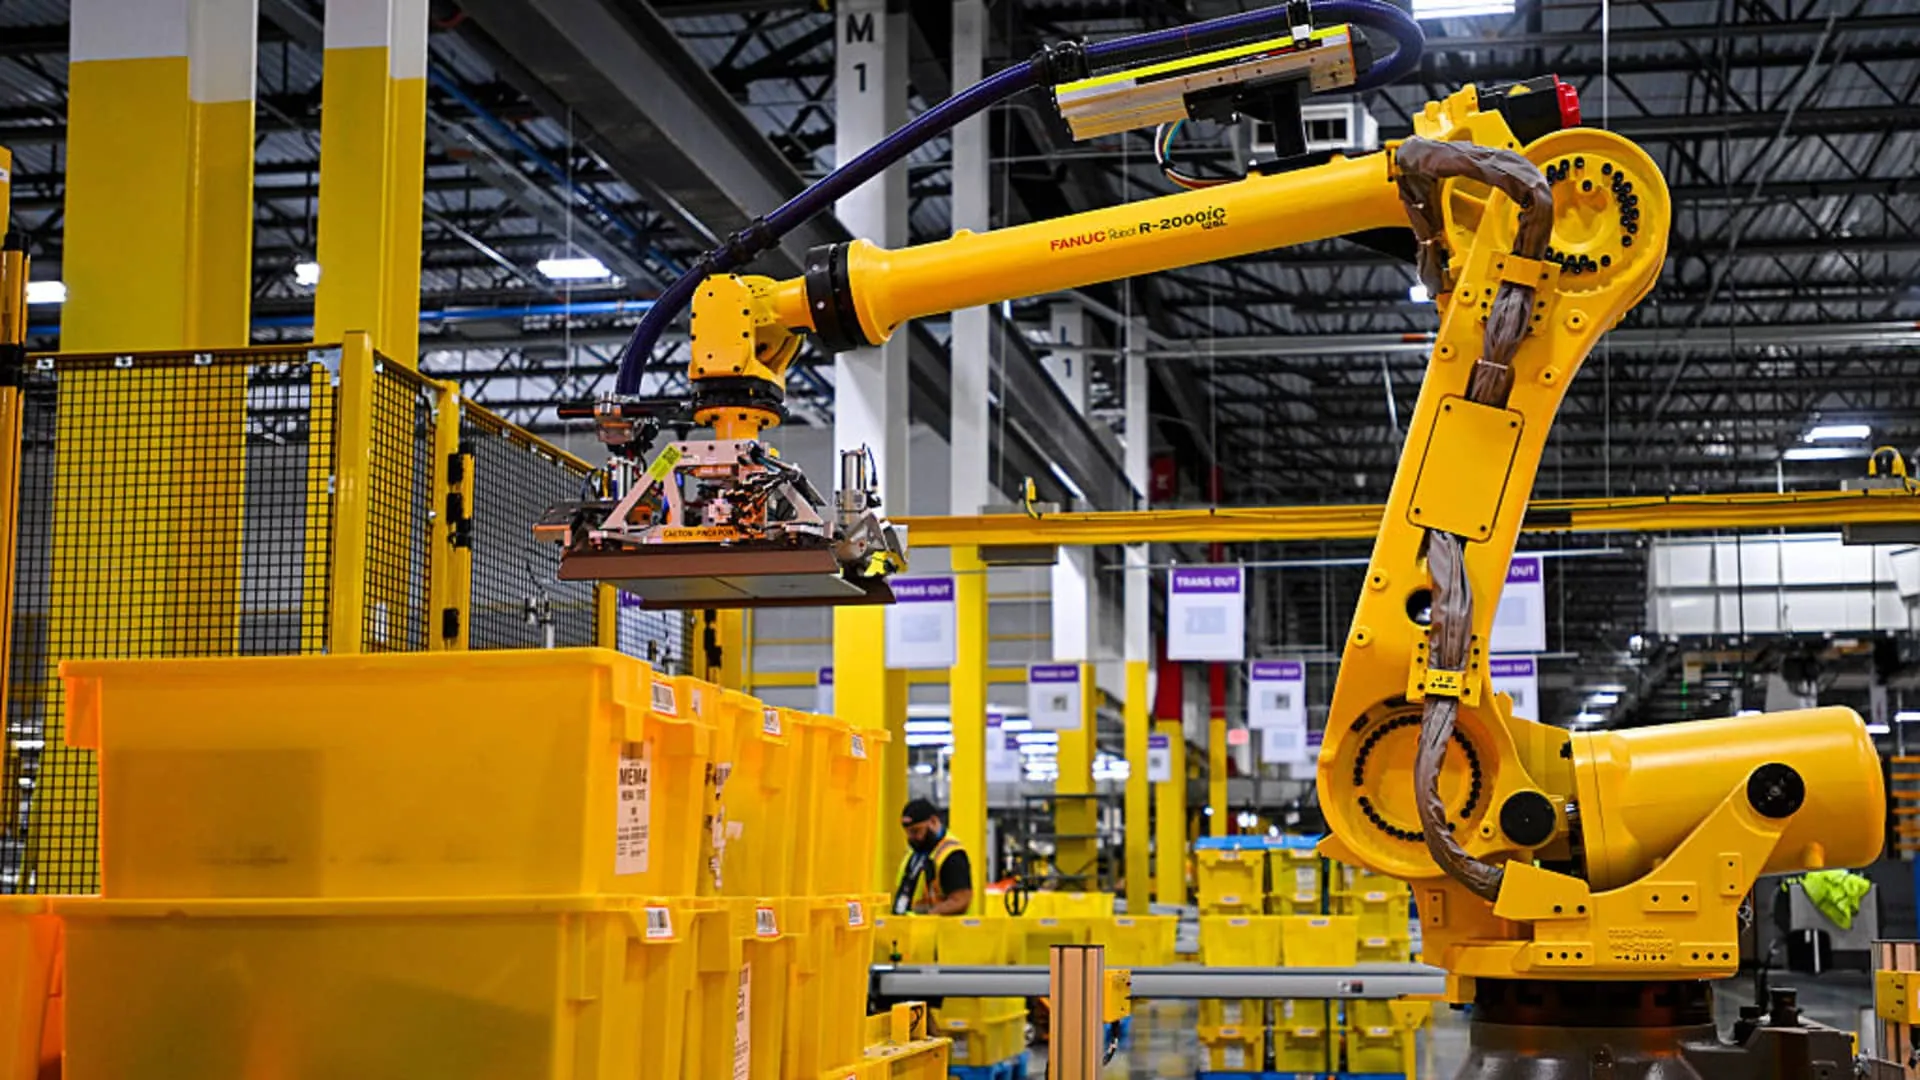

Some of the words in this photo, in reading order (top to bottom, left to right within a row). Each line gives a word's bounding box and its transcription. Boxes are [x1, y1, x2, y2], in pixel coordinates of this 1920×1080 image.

[846, 13, 874, 44] M
[853, 62, 866, 92] 1
[1050, 230, 1106, 251] FANUC
[1063, 358, 1072, 378] 1
[1511, 564, 1535, 577] OUT
[927, 584, 950, 596] OUT
[1176, 576, 1211, 588] TRANS
[1213, 576, 1236, 588] OUT
[619, 767, 648, 786] MEM4
